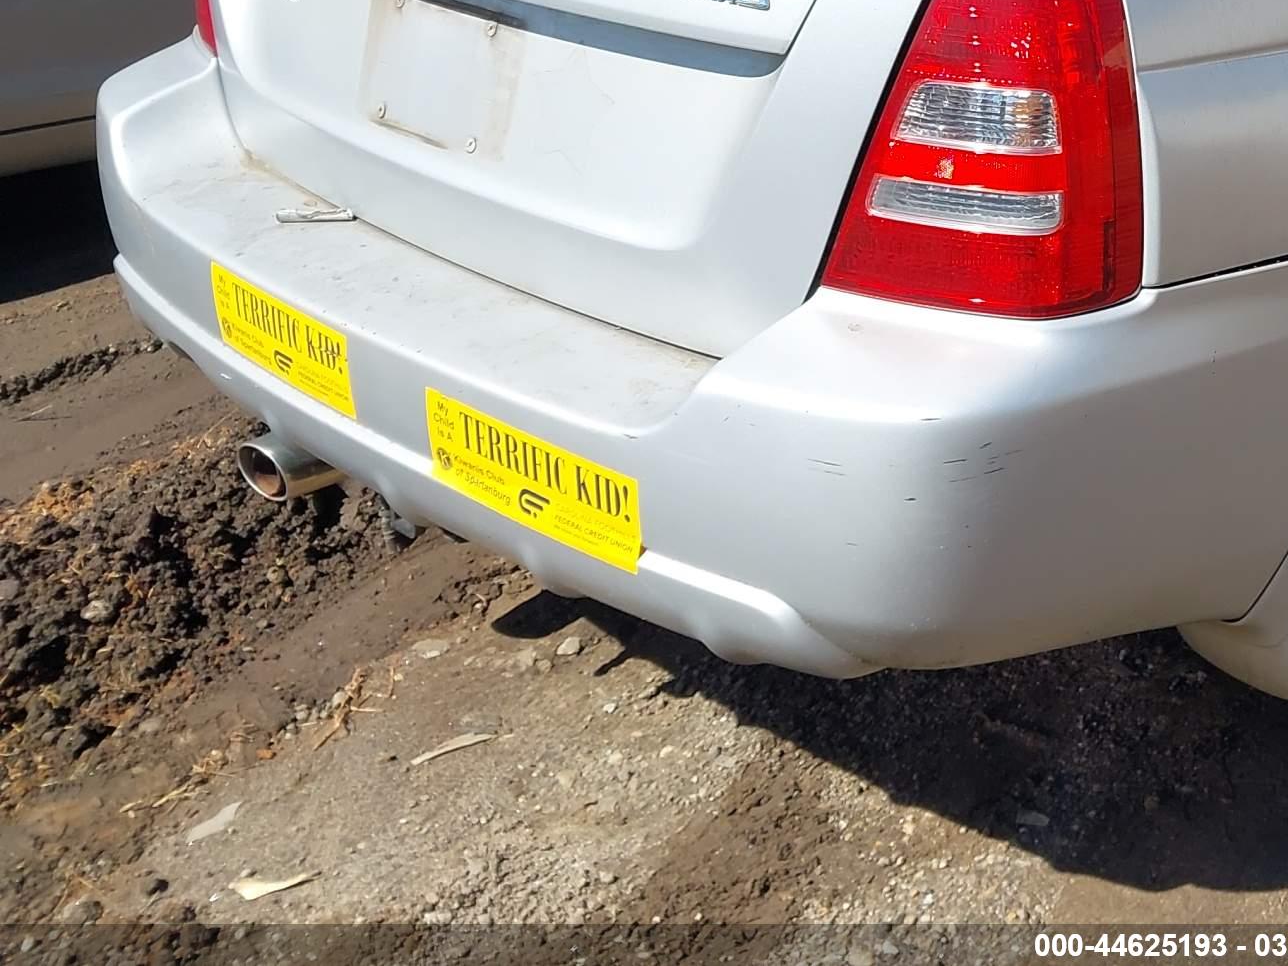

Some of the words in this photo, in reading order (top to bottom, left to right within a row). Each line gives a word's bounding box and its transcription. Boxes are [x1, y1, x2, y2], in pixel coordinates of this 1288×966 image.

[232, 282, 302, 353] TERRIFIC
[305, 324, 344, 374] KID!
[433, 412, 455, 431] Child
[459, 412, 567, 494] TERRIFIC
[574, 465, 631, 522] KID!
